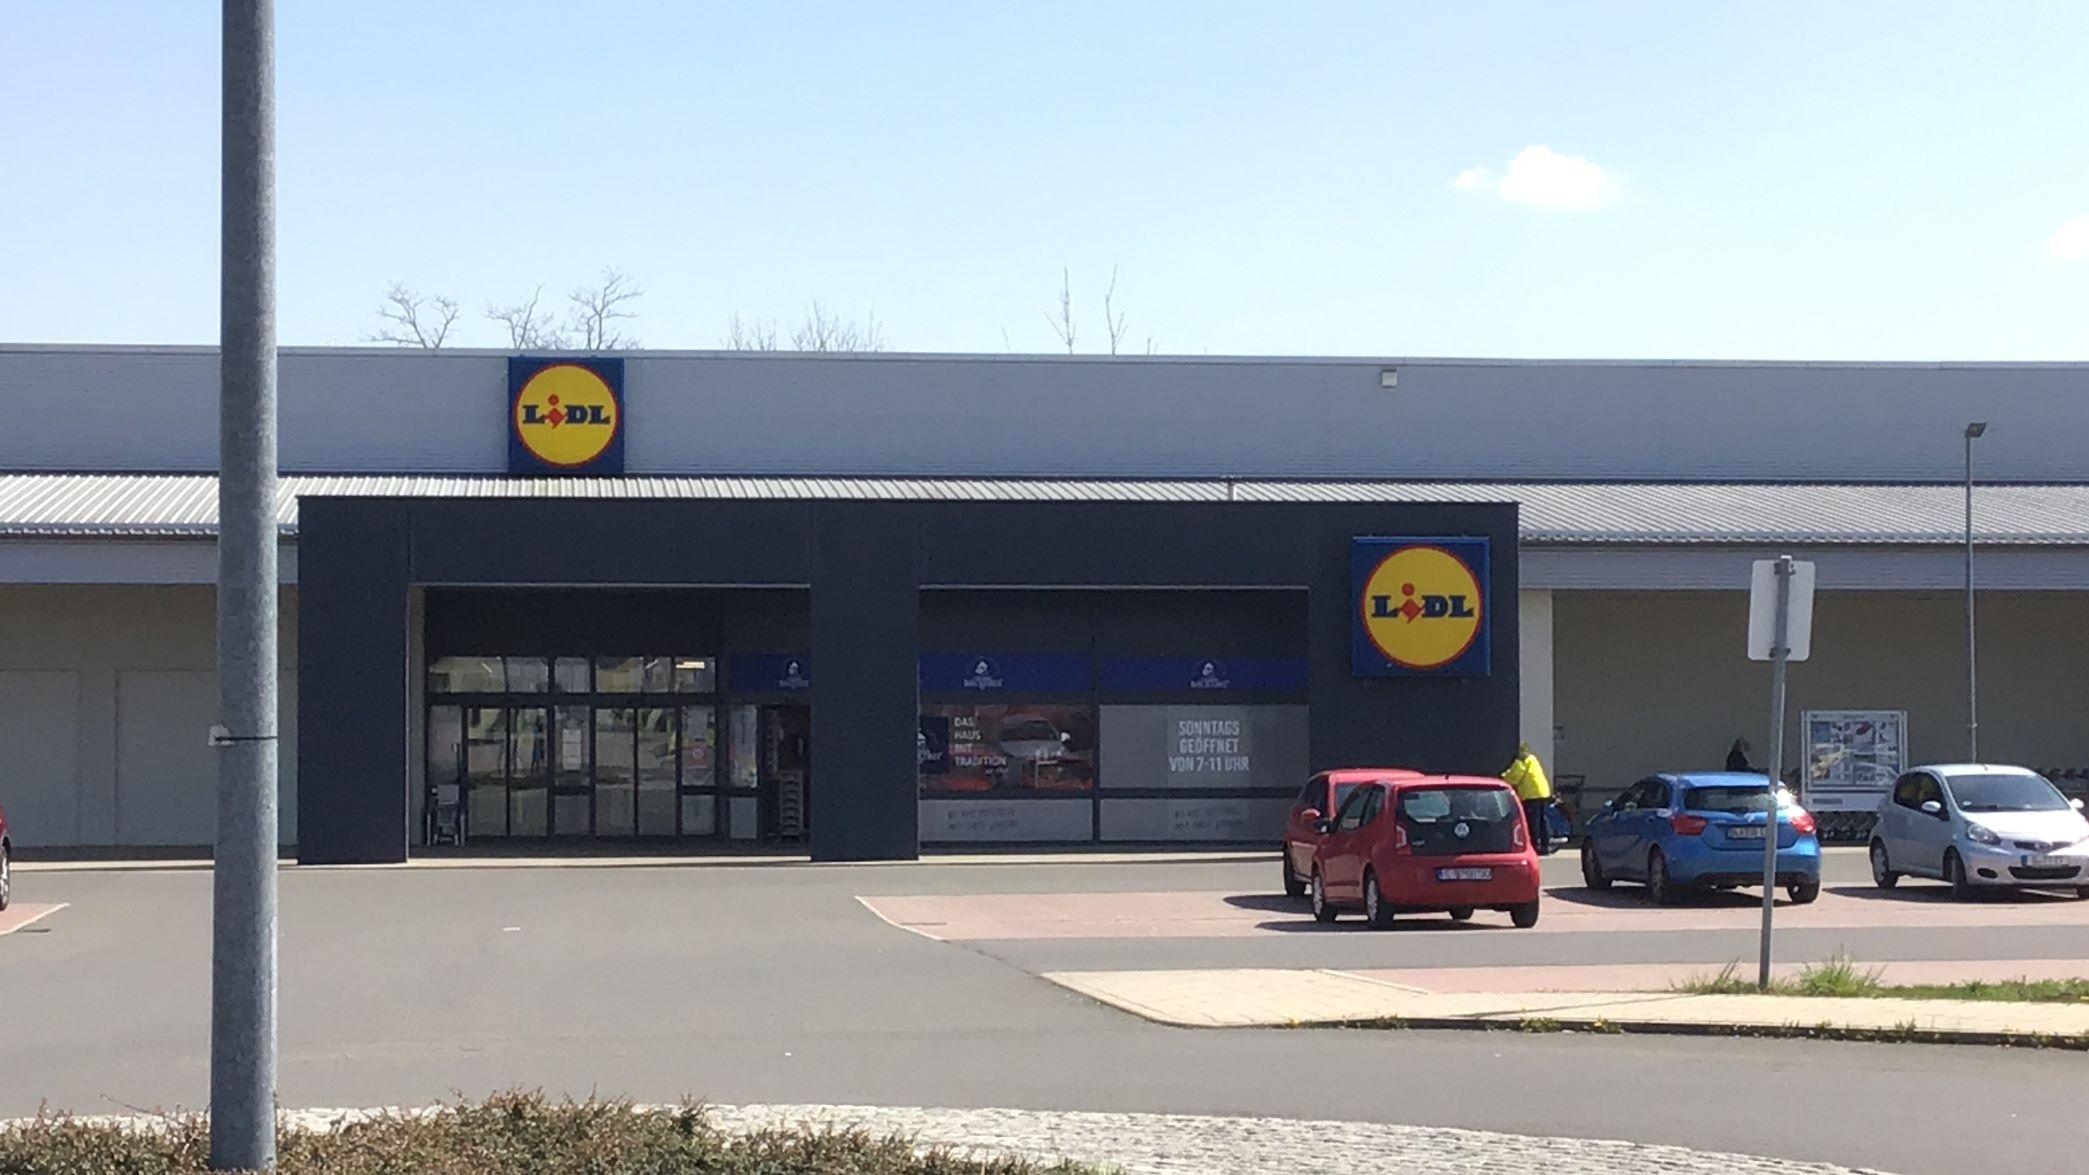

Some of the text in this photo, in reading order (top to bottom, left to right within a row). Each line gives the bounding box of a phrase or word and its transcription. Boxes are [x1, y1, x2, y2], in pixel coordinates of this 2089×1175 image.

[954, 717, 975, 727] DAS
[1179, 720, 1239, 735] SONNTAGS
[954, 730, 981, 740] HAUS
[1180, 736, 1239, 753] GEÖFFNET
[955, 756, 1007, 767] TRADITION
[1169, 756, 1249, 772] VON 7-11 UHR
